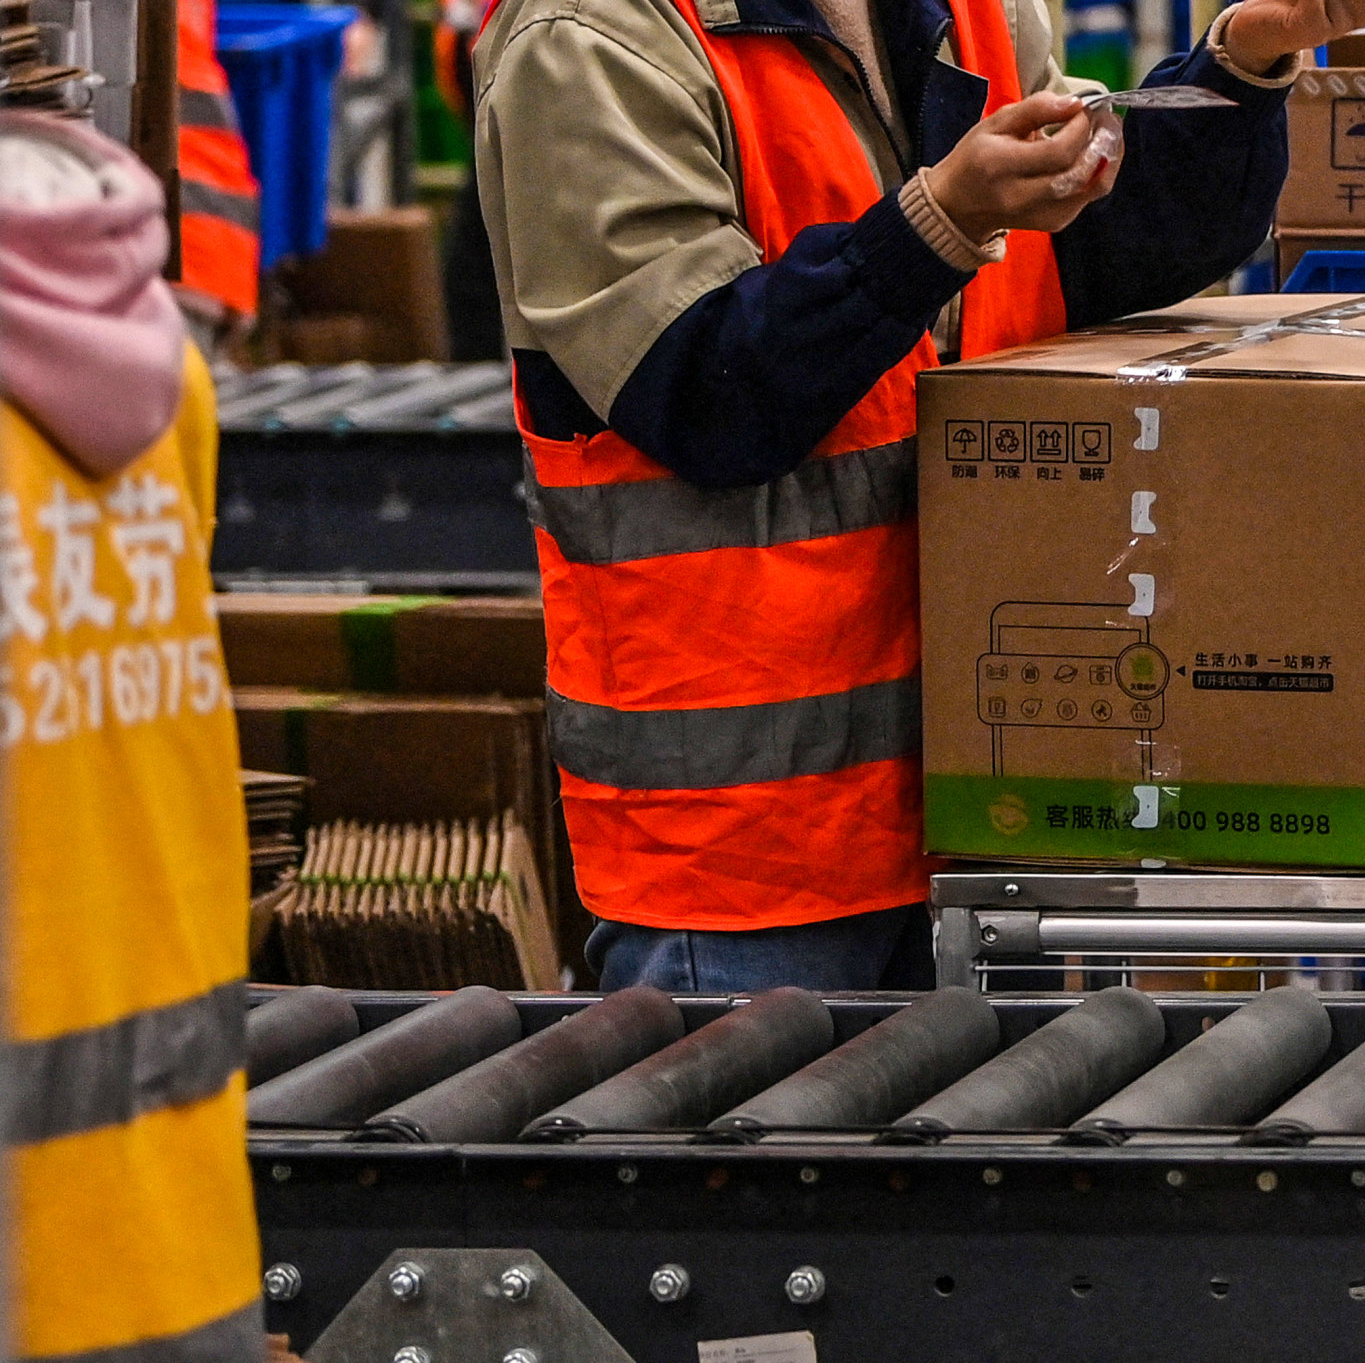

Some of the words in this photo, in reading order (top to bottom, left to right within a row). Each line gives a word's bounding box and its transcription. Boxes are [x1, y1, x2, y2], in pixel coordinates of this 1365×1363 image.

[951, 465, 978, 479] 防潮
[994, 465, 1020, 479] 环保
[1036, 467, 1062, 480] 向上
[1079, 467, 1105, 482] 易碎
[1194, 652, 1259, 669] 生活小事
[1267, 654, 1334, 671] 一站购齐
[1216, 811, 1260, 833] 988
[1269, 813, 1330, 835] 8898
